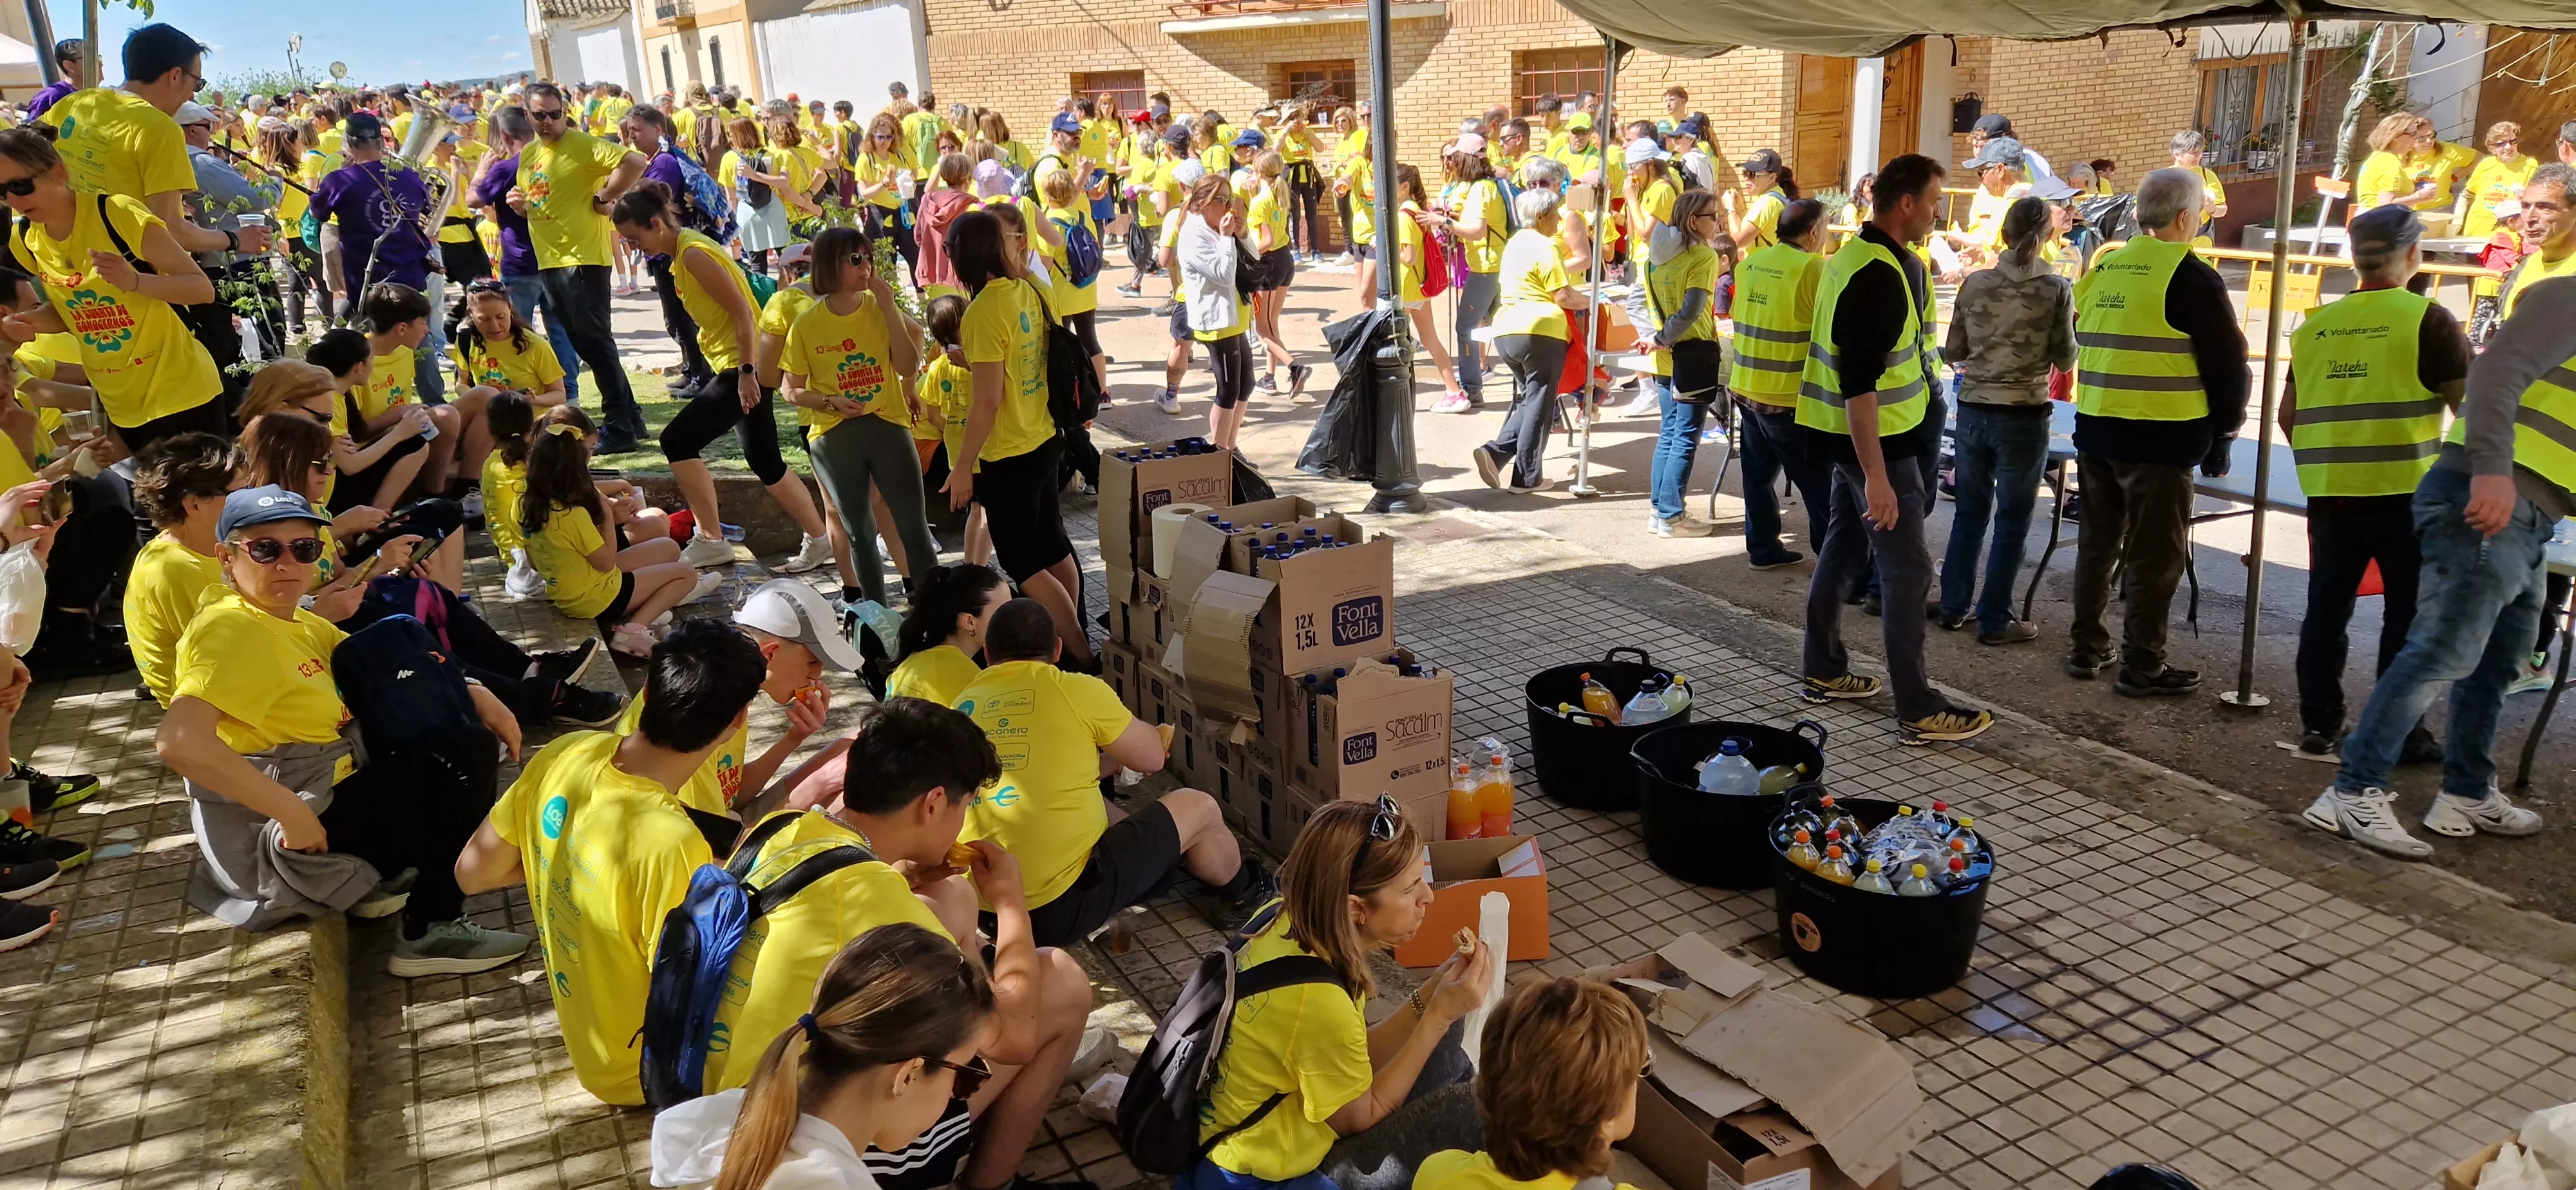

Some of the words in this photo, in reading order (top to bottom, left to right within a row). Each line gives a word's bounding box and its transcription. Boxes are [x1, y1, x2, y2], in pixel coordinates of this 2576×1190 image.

[2107, 263, 2151, 271] Voluntariado
[83, 305, 117, 319] SUERTE
[116, 304, 129, 316] DE
[75, 316, 135, 333] CONOCERNOS
[815, 345, 824, 355] 13
[848, 367, 873, 379] SUERTE
[838, 373, 885, 391] CONOCERNOS
[1179, 477, 1227, 499] Sacalm
[1146, 492, 1168, 504] Font
[1337, 601, 1378, 623] Font
[1295, 612, 1314, 630] 12X
[1336, 618, 1379, 641] Vella
[1295, 630, 1319, 652] 1,5L
[298, 663, 312, 679] 13
[984, 726, 1028, 736] scanero
[1386, 712, 1443, 741] Sacalm
[1347, 736, 1374, 751] Font
[1347, 747, 1374, 762] Vella
